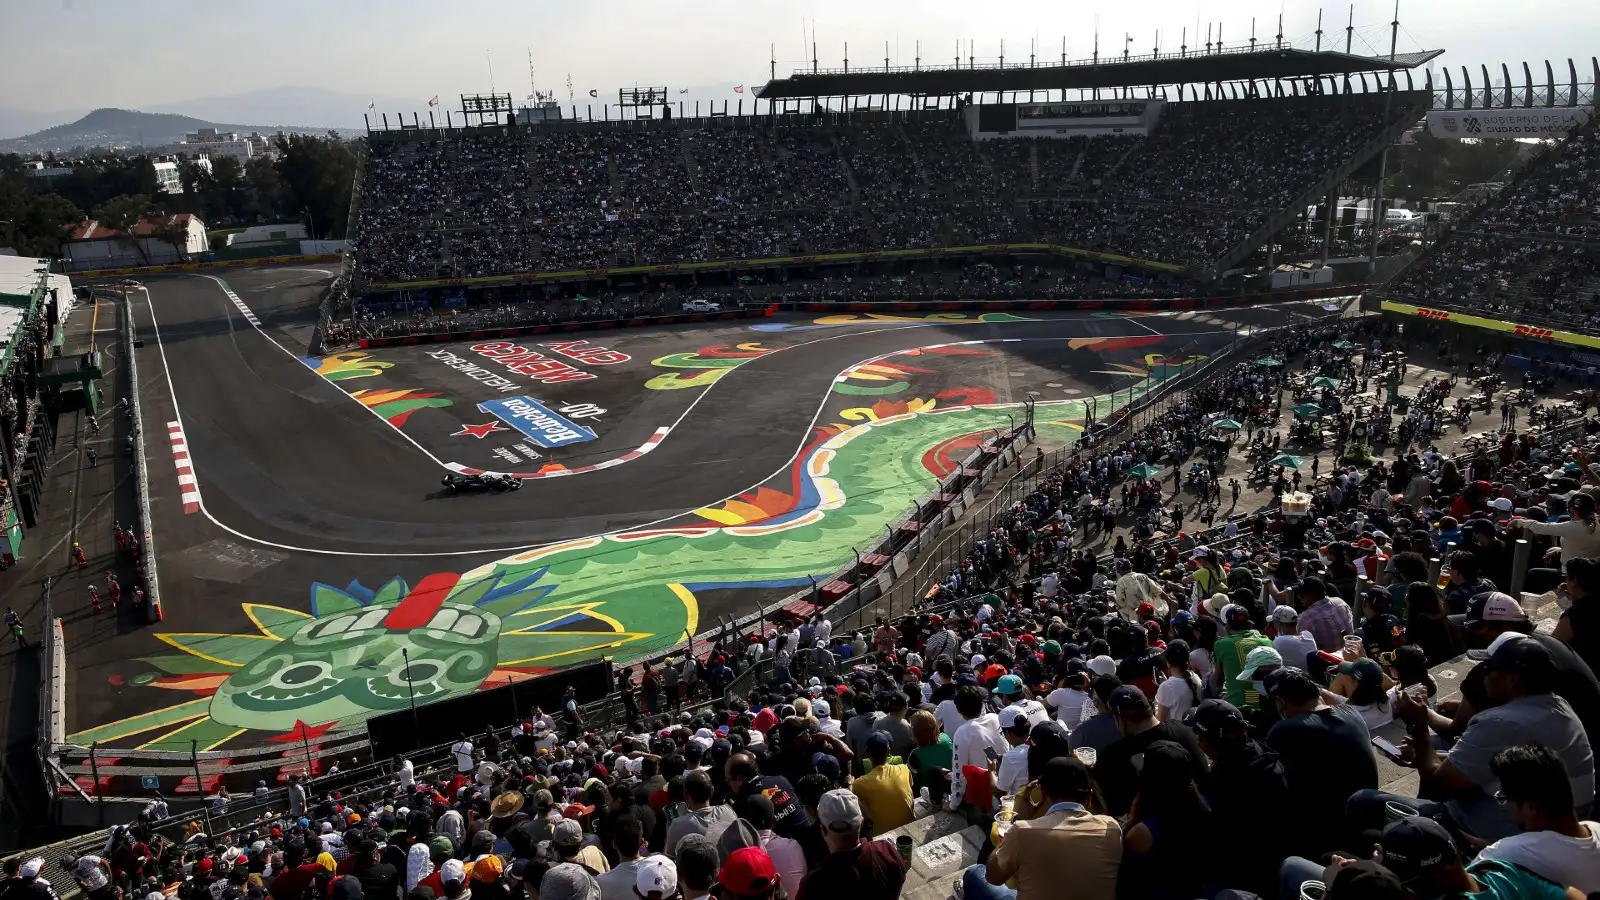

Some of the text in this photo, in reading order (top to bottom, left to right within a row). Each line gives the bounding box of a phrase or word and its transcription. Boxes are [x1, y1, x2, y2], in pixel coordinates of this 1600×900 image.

[1484, 115, 1539, 124] GOBIERNO
[1543, 115, 1560, 123] DE
[1417, 307, 1450, 321] DHL
[1514, 325, 1553, 340] DHL
[537, 339, 632, 365] CITY
[425, 349, 521, 393] WELCOME BACK
[501, 398, 584, 444] Heineken
